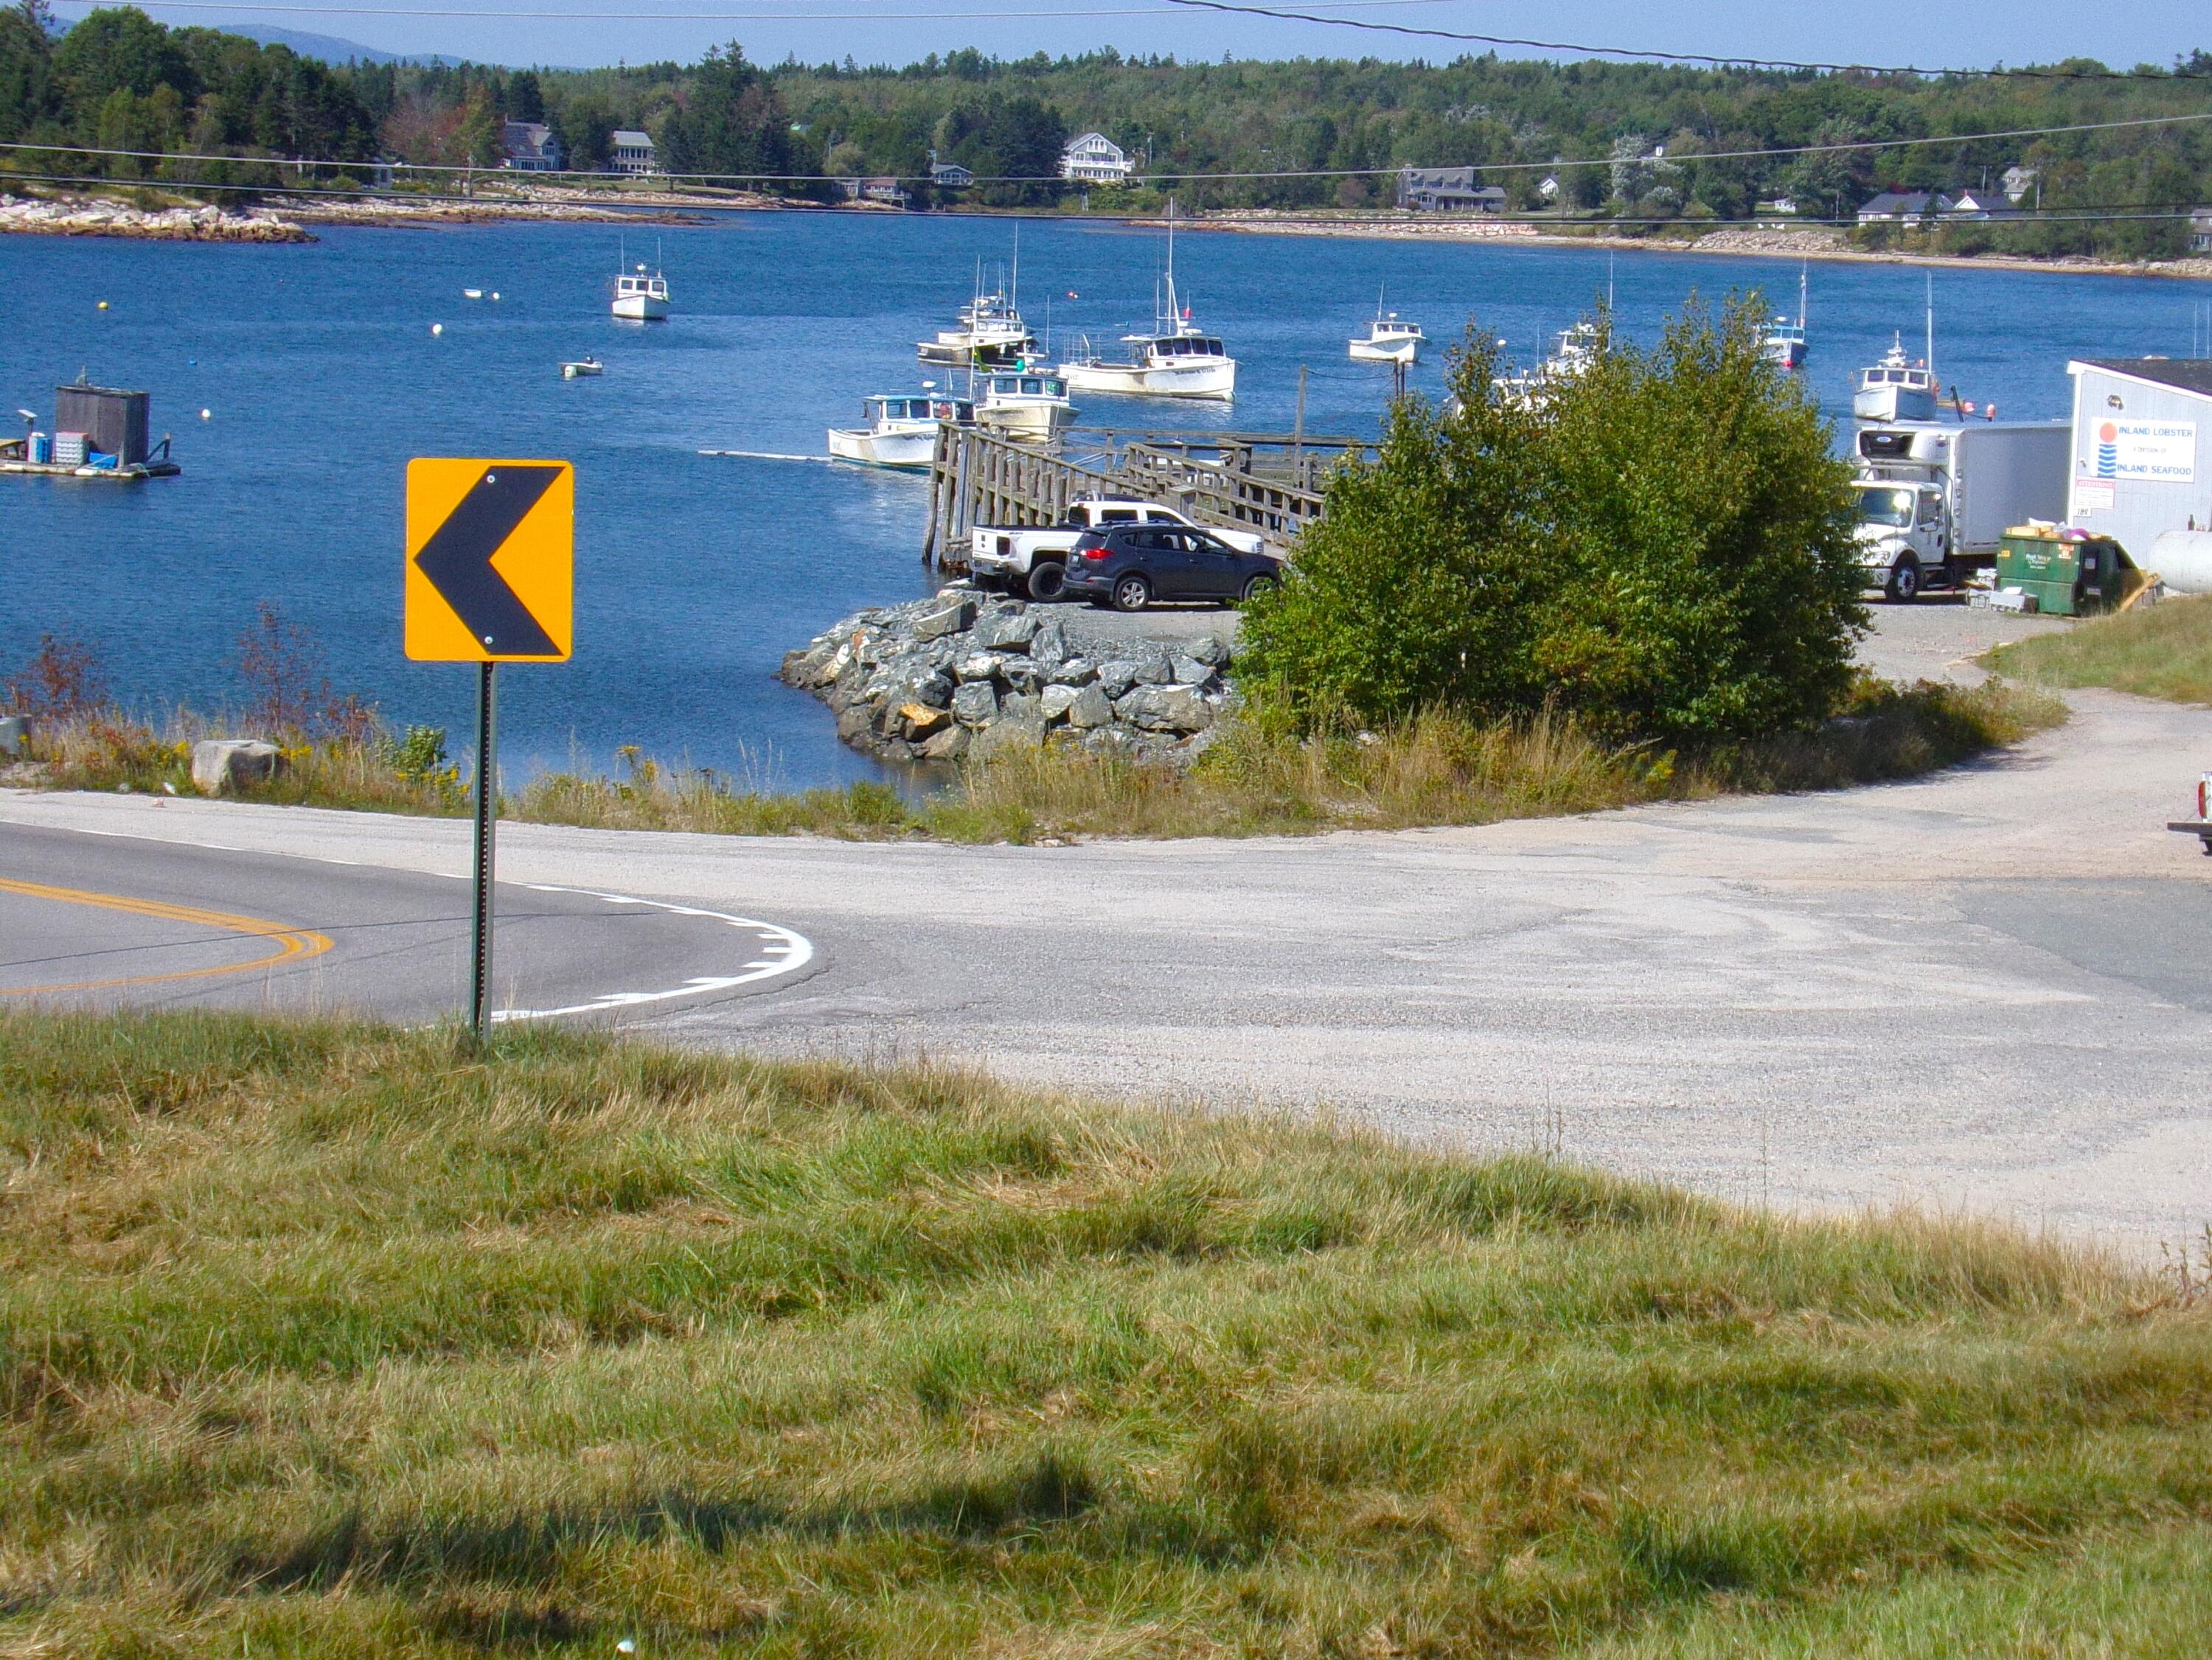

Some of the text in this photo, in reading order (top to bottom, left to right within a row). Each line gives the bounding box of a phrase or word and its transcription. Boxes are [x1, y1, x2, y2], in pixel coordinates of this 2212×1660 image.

[2118, 426, 2193, 437] INLAND LOBSTER
[2117, 464, 2192, 475] INLAND SEAFOOD
